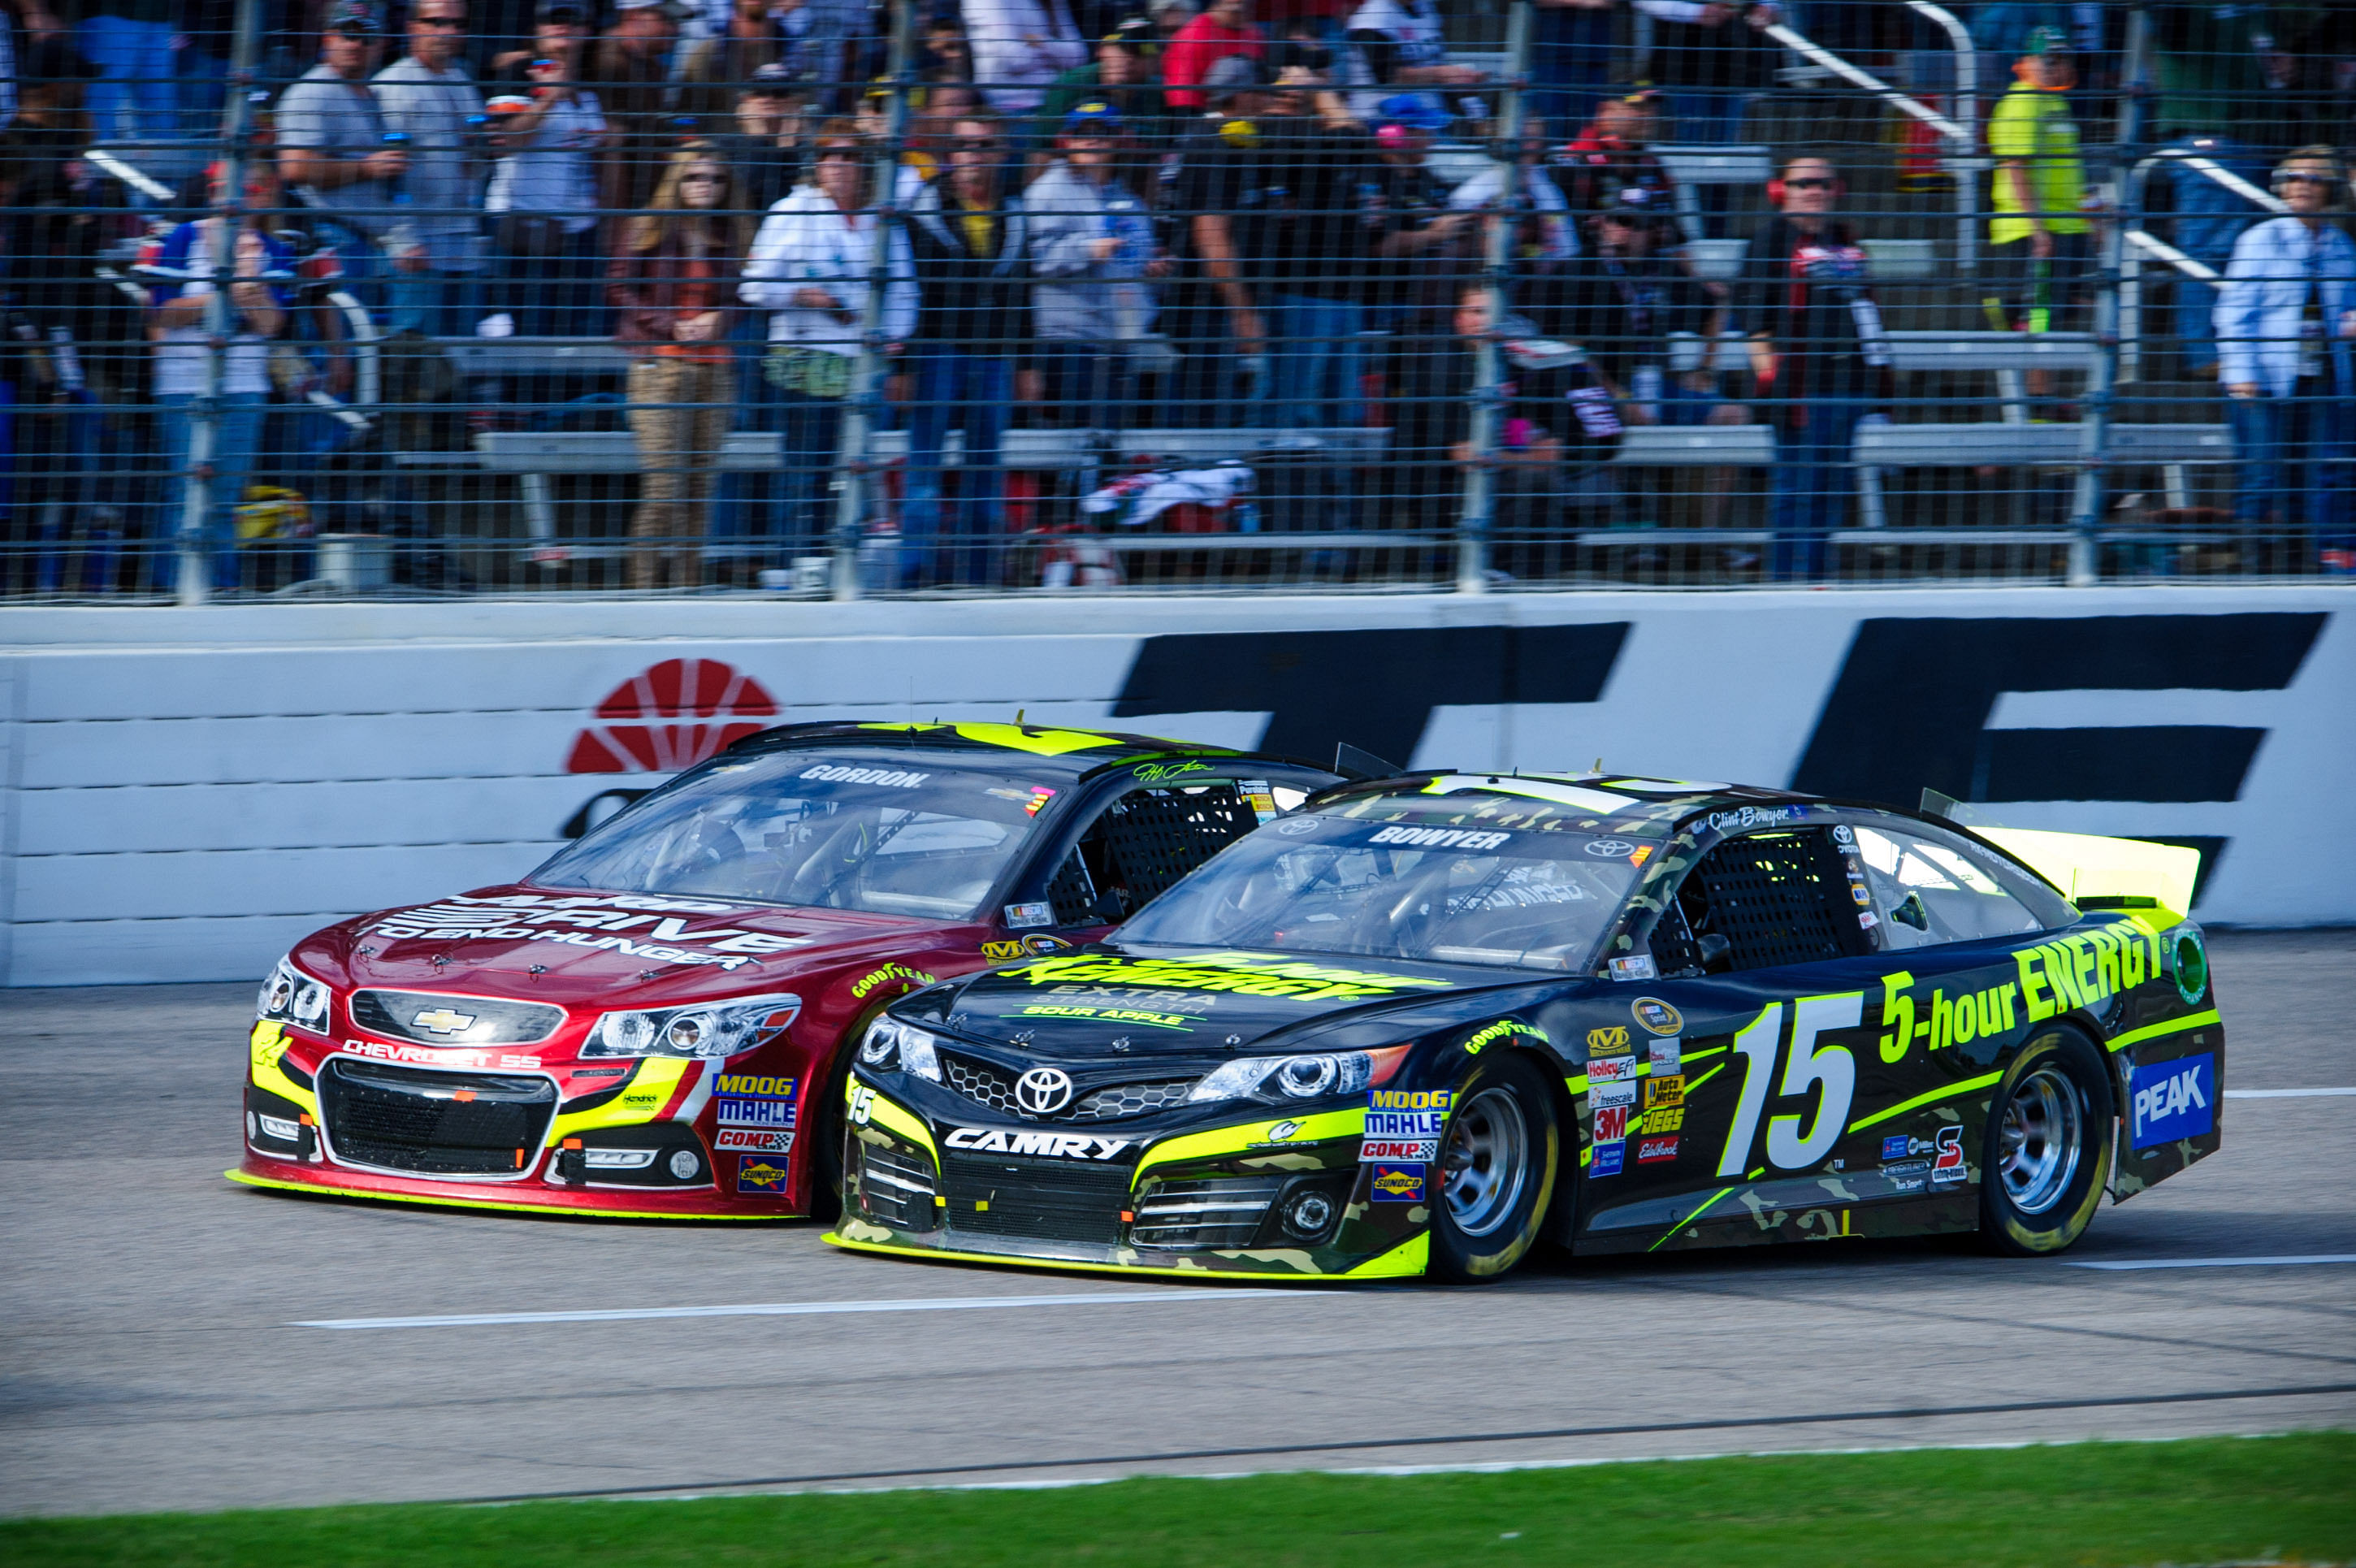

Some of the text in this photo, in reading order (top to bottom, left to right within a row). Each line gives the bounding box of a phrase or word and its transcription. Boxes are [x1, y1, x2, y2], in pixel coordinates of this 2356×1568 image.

[799, 765, 931, 788] GORDON
[1709, 806, 1790, 830] Clint Bowyer
[1368, 825, 1512, 850] BOWYER
[419, 928, 535, 939] END
[529, 929, 750, 972] HUNGER
[1048, 985, 1218, 1006] EXTRA
[1879, 970, 2017, 1064] 5-hour
[2011, 915, 2162, 1024] ENERGY
[1023, 1006, 1185, 1025] SOUR APPLE
[1033, 995, 1206, 1015] STRENGTH
[1464, 1020, 1549, 1055] GOODYEAR
[343, 1039, 543, 1069] CHEVROLET SS
[1588, 1059, 1619, 1079] Holley
[715, 1074, 795, 1096] MOOG
[1657, 1079, 1678, 1091] Auto
[1716, 990, 1864, 1177] 15
[847, 1085, 877, 1124] 15
[1371, 1089, 1449, 1109] MOOG
[1600, 1092, 1633, 1106] freescale
[1656, 1090, 1683, 1102] Meter
[2135, 1064, 2207, 1138] PEAK
[719, 1099, 796, 1123] MAHLE
[1641, 1108, 1686, 1135] JEGS
[1365, 1113, 1442, 1133] MAHLE
[1595, 1107, 1627, 1141] 3M
[719, 1131, 775, 1147] COMP
[756, 1143, 783, 1151] CAMS
[944, 1128, 1130, 1160] CAMRY
[1362, 1142, 1420, 1157] COMP
[1639, 1141, 1678, 1159] Edelbrock
[743, 1169, 784, 1180] SUNOCO
[1375, 1179, 1420, 1188] SUNOCO
